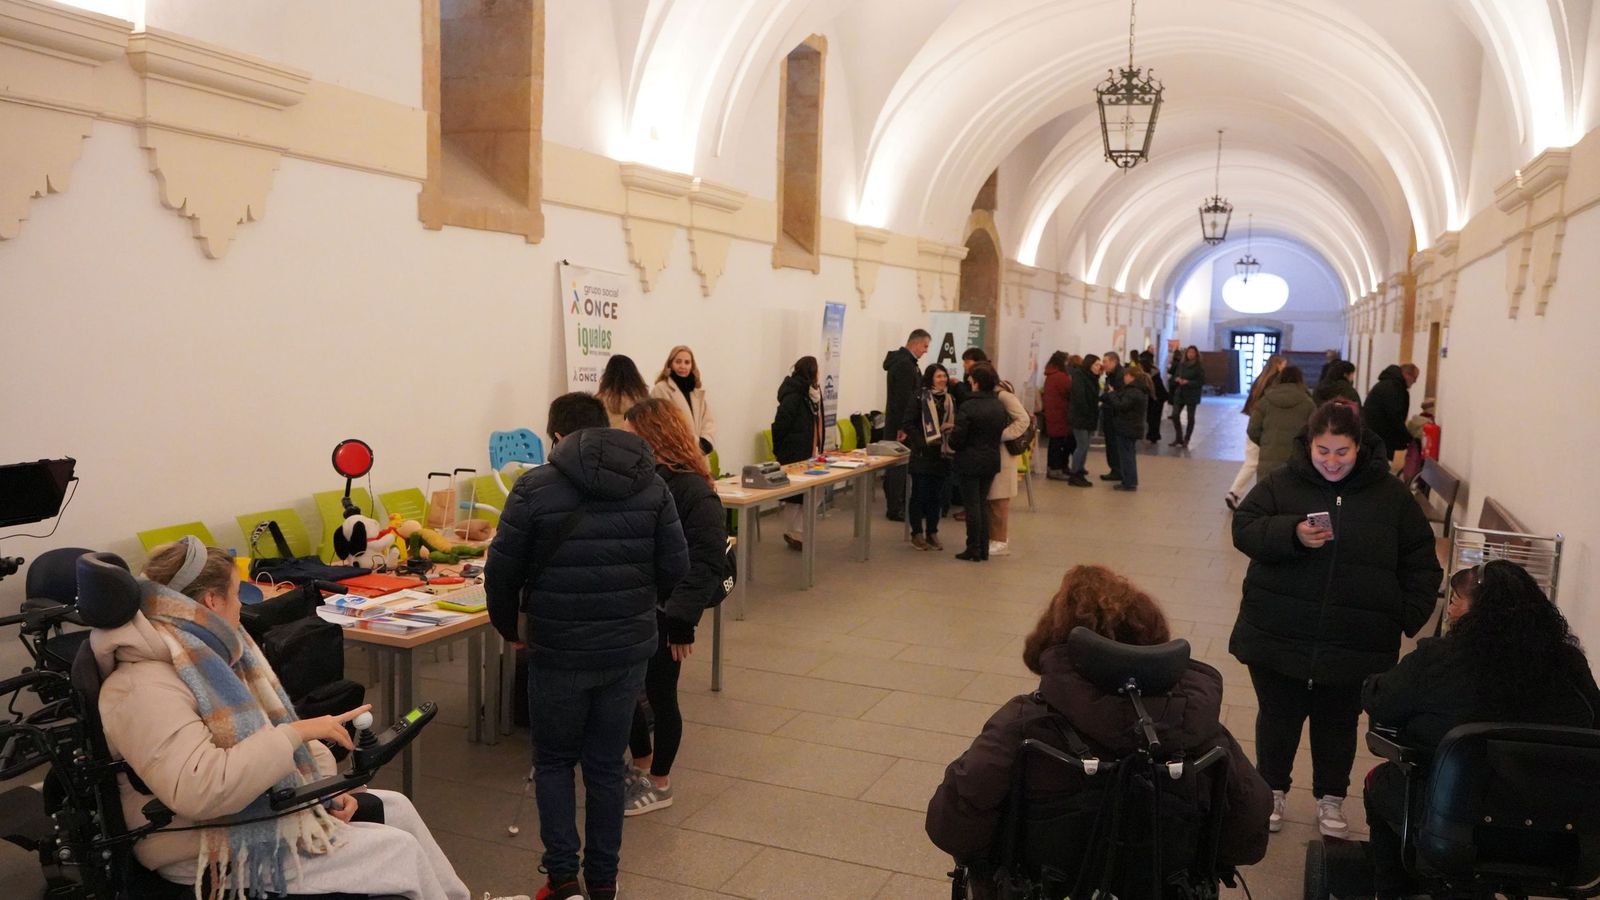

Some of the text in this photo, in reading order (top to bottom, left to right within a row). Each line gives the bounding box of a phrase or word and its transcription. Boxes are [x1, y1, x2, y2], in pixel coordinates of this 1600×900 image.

[583, 285, 620, 298] grupo social
[584, 298, 618, 320] ONCE
[577, 322, 612, 356] iguales
[578, 372, 598, 383] ONCE
